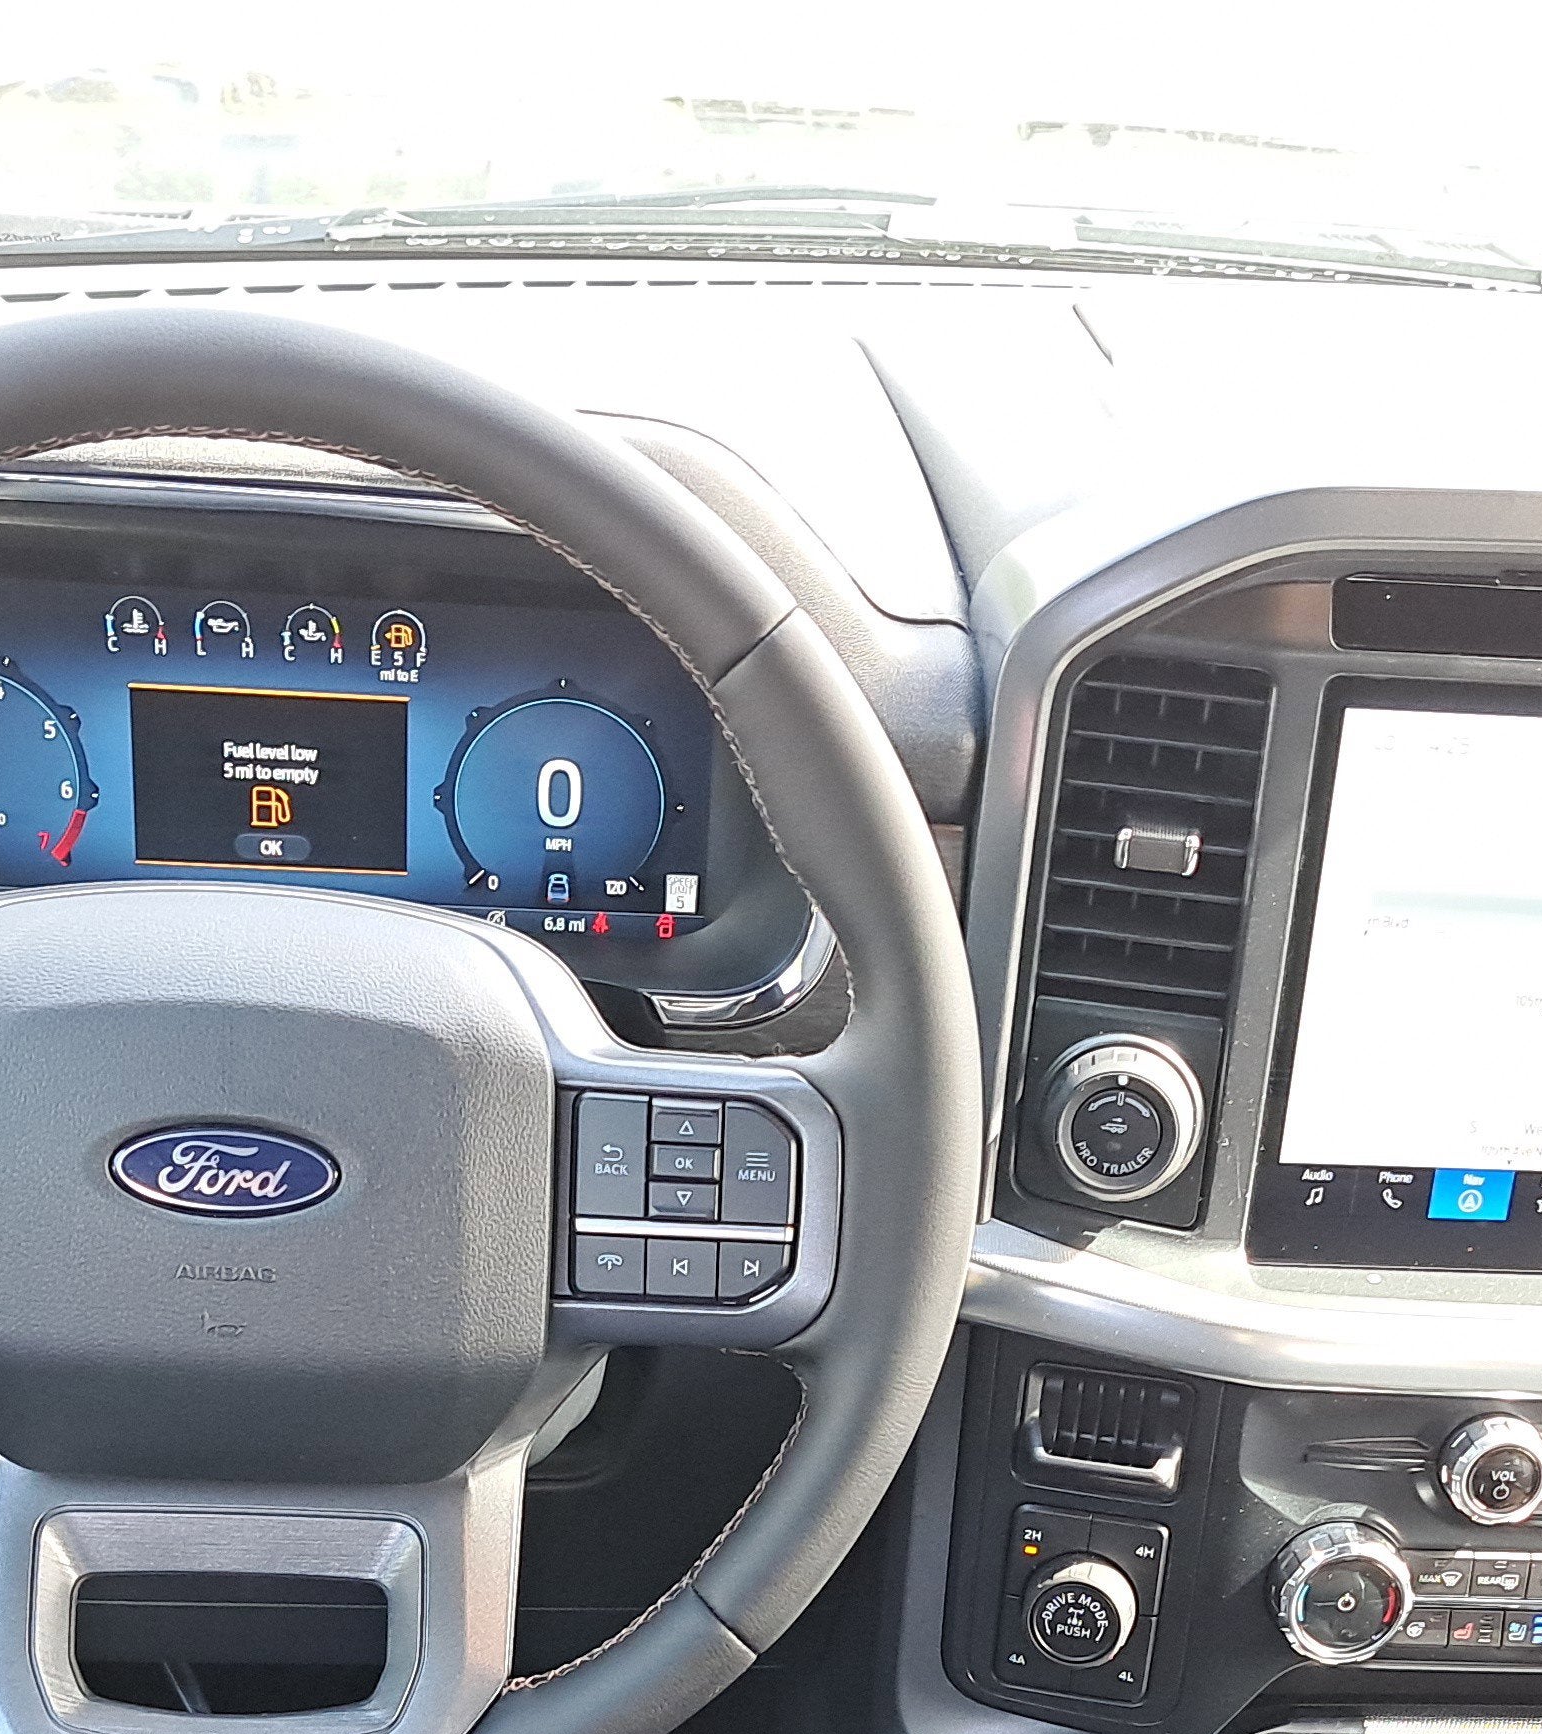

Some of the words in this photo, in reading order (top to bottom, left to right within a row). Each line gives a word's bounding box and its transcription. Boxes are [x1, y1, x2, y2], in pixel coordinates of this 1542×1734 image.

[107, 637, 119, 652] C
[155, 638, 167, 655] H
[197, 640, 207, 656] L
[242, 642, 254, 658] H
[284, 646, 295, 661] C
[331, 648, 343, 664] H
[371, 650, 381, 666] E
[393, 651, 403, 666] 5
[416, 652, 426, 668] F
[396, 668, 409, 682] to
[410, 669, 419, 682] E
[44, 720, 57, 738] 5
[223, 742, 255, 759] Fuel
[255, 743, 289, 760] level
[291, 745, 318, 761] low
[223, 762, 233, 778] 5
[235, 764, 253, 779] mi
[255, 765, 271, 780] to
[273, 766, 319, 785] empty
[60, 780, 73, 799] 6
[538, 758, 582, 827] 0
[37, 831, 51, 850] 7
[260, 840, 283, 856] OK
[545, 838, 572, 852] MPH
[487, 875, 499, 891] 0
[604, 880, 627, 895] 120
[676, 895, 685, 909] 5
[674, 1157, 694, 1170] OK
[1074, 1141, 1098, 1167] PRO
[1101, 1147, 1154, 1175] TRAILER
[158, 1140, 293, 1198] Ford
[594, 1162, 629, 1176] BACK
[737, 1170, 776, 1182] MENU
[1301, 1169, 1334, 1181] Audio
[1379, 1171, 1413, 1184] Phone
[1463, 1173, 1486, 1185] Nav
[174, 1263, 278, 1284] AIRBAG
[1490, 1469, 1517, 1483] VOL
[1023, 1529, 1042, 1542] 2H
[1135, 1546, 1155, 1559] 4H
[1041, 1592, 1076, 1621] DRIVE
[1078, 1593, 1109, 1628] MODE
[1056, 1623, 1091, 1639] PUSH
[1008, 1653, 1026, 1667] 4A
[1118, 1670, 1134, 1683] 4L
